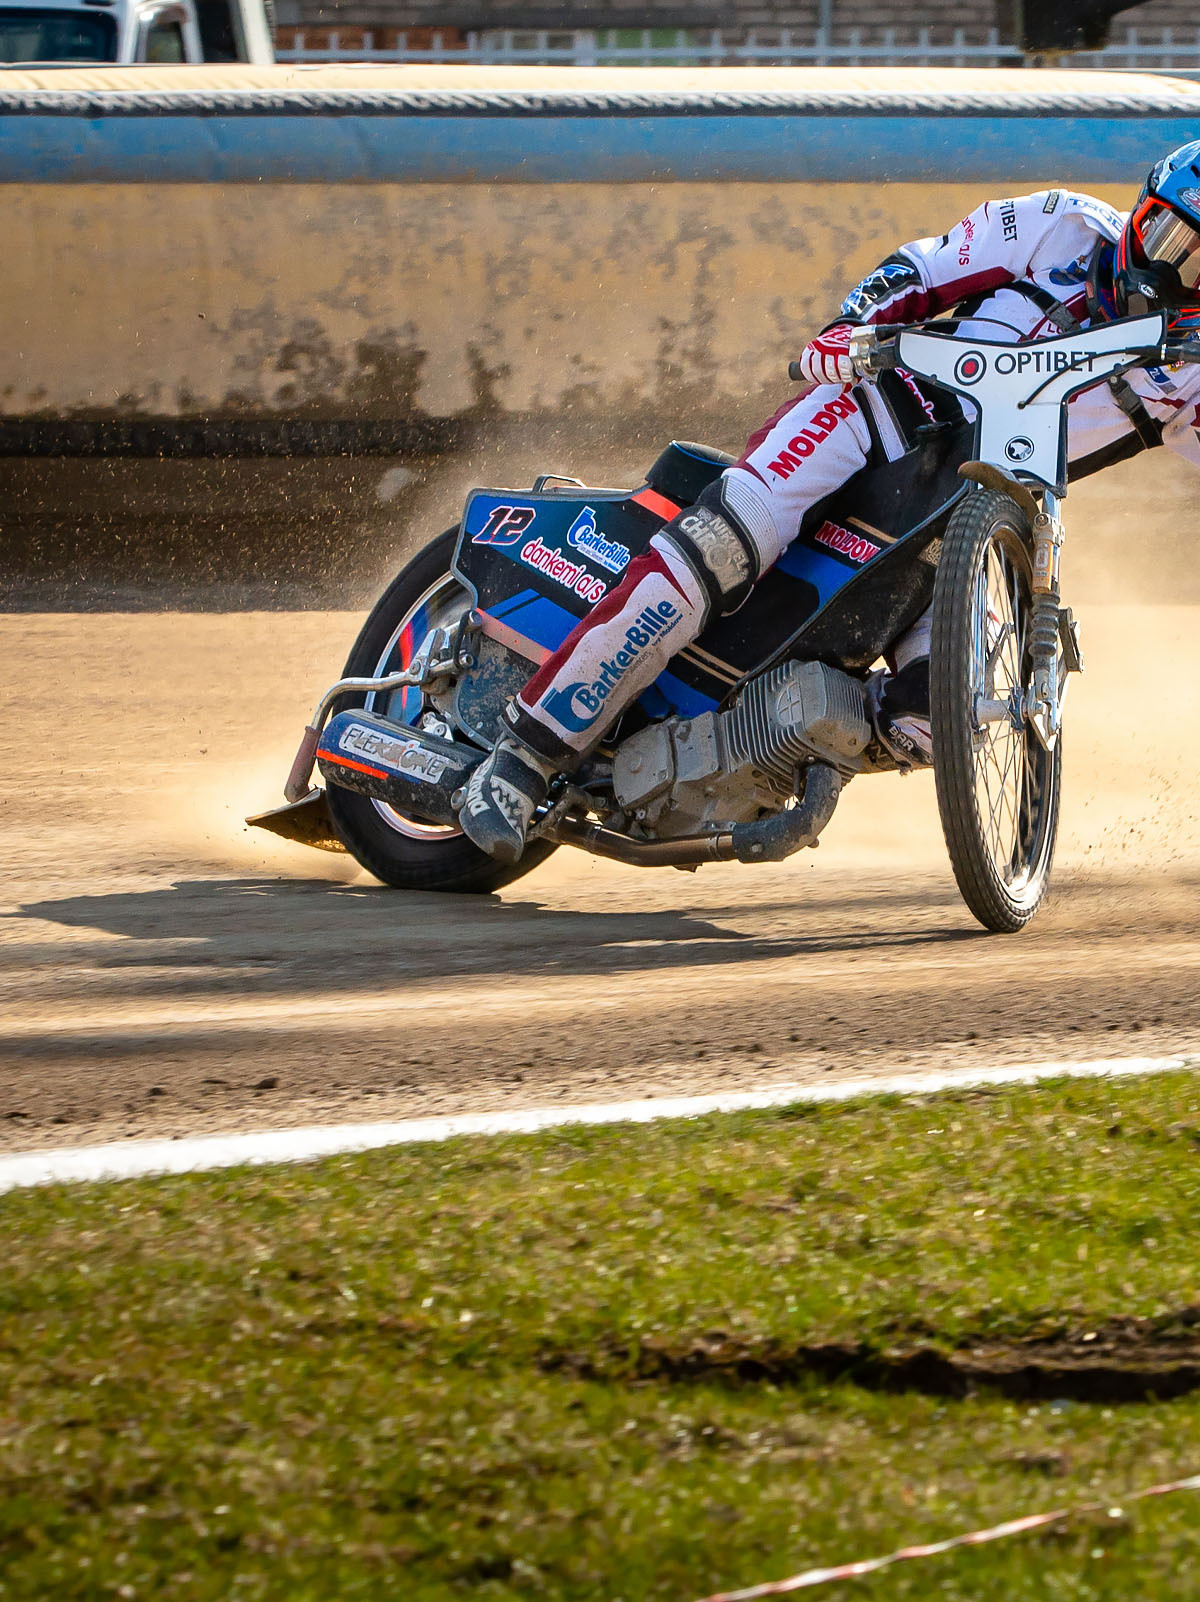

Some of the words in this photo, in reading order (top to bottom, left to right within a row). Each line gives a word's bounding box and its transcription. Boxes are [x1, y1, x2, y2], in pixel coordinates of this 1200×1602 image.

[1000, 200, 1018, 242] TIBET
[994, 351, 1097, 375] OPTIBET
[472, 505, 536, 546] 12
[815, 520, 881, 563] MOLDOW
[579, 526, 631, 568] BarkerBille
[521, 537, 585, 588] dankemi
[575, 577, 606, 603] a/s
[574, 600, 677, 713] BarkerBille
